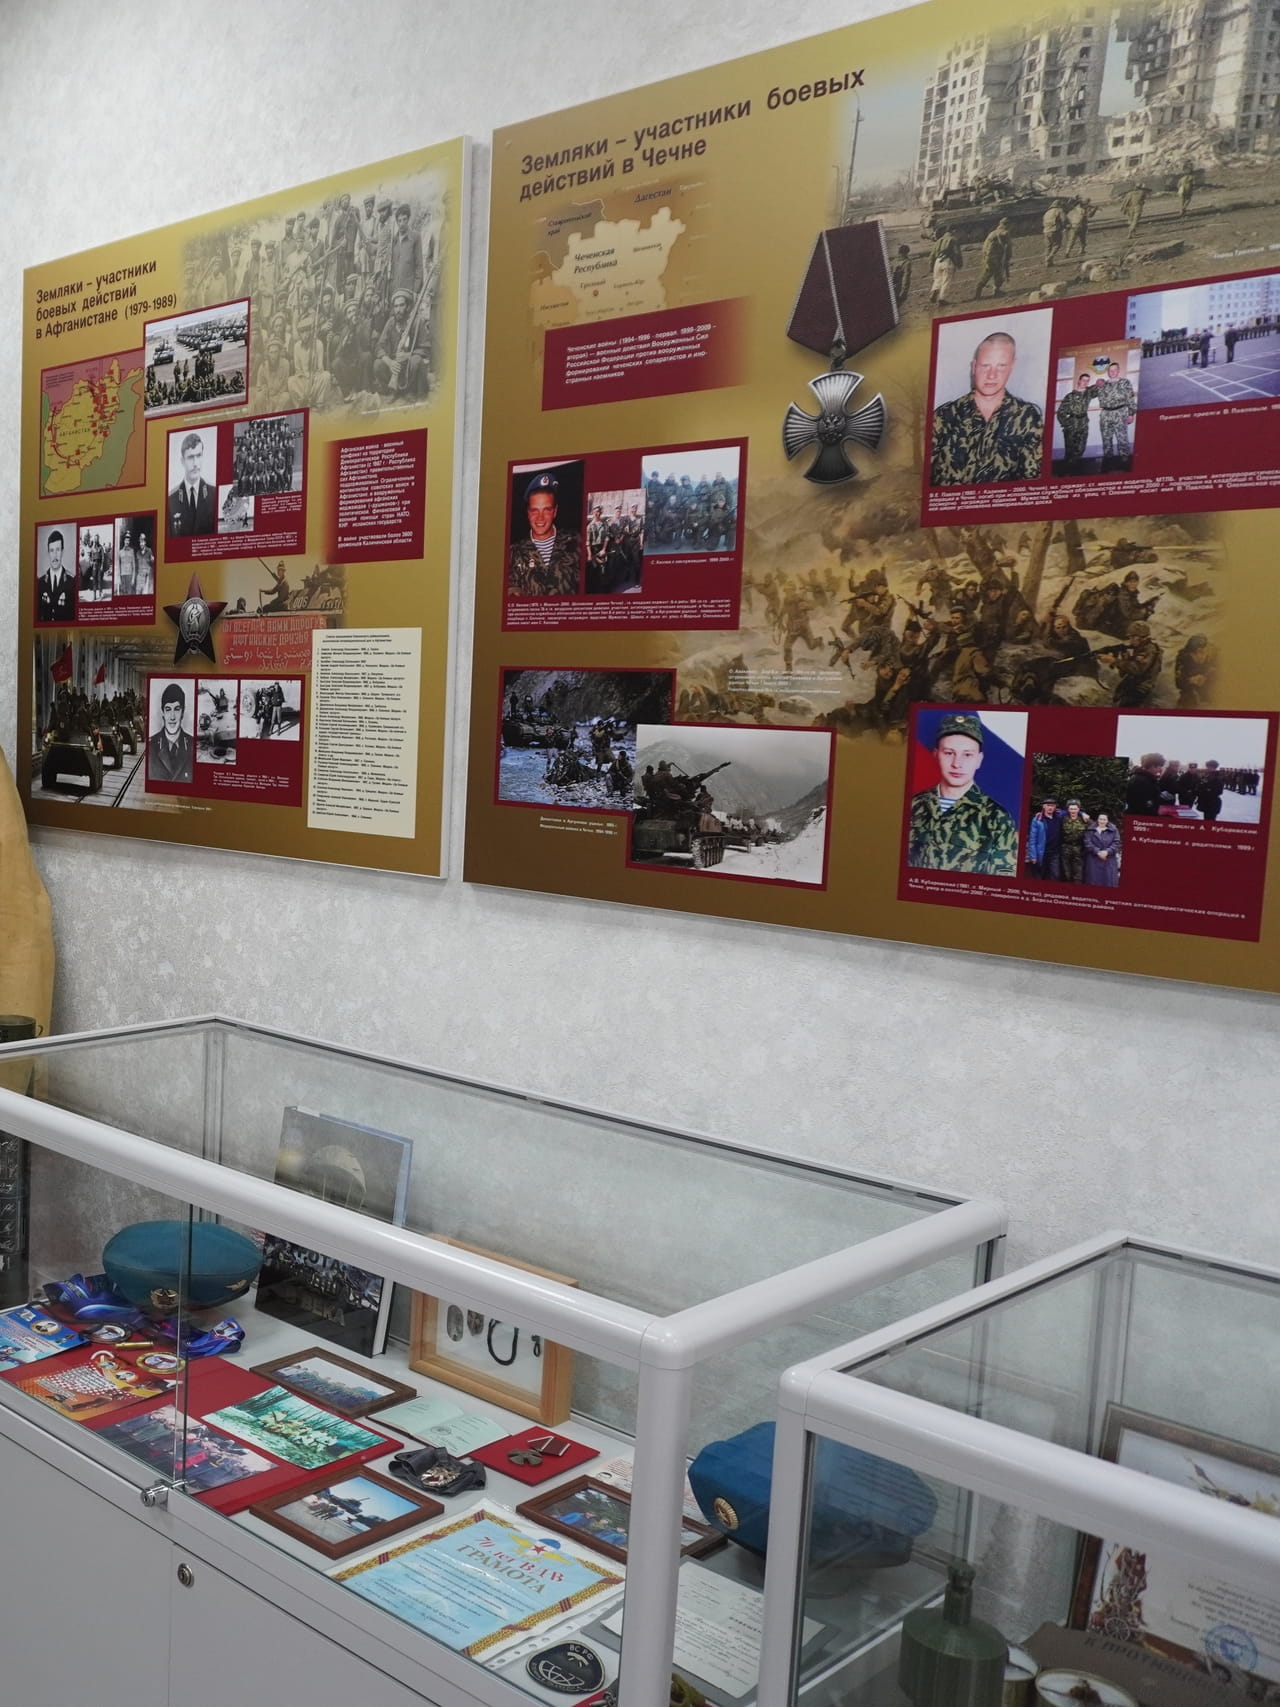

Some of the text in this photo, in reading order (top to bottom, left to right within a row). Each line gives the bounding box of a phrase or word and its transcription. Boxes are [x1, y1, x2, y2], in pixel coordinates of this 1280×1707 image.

[521, 137, 608, 175] Земляки
[634, 99, 751, 151] участники
[767, 69, 865, 111] боевых
[520, 137, 707, 202] действий в Чечне
[573, 259, 618, 274] Республика
[574, 248, 615, 261] Чеченская
[36, 281, 83, 304] Земляки
[96, 260, 157, 291] участники
[36, 283, 137, 321] боевых действий
[36, 293, 177, 339] в Афганистане (1979-1989)
[457, 1543, 546, 1593] ГРАМОТА
[569, 1644, 581, 1653] ВС
